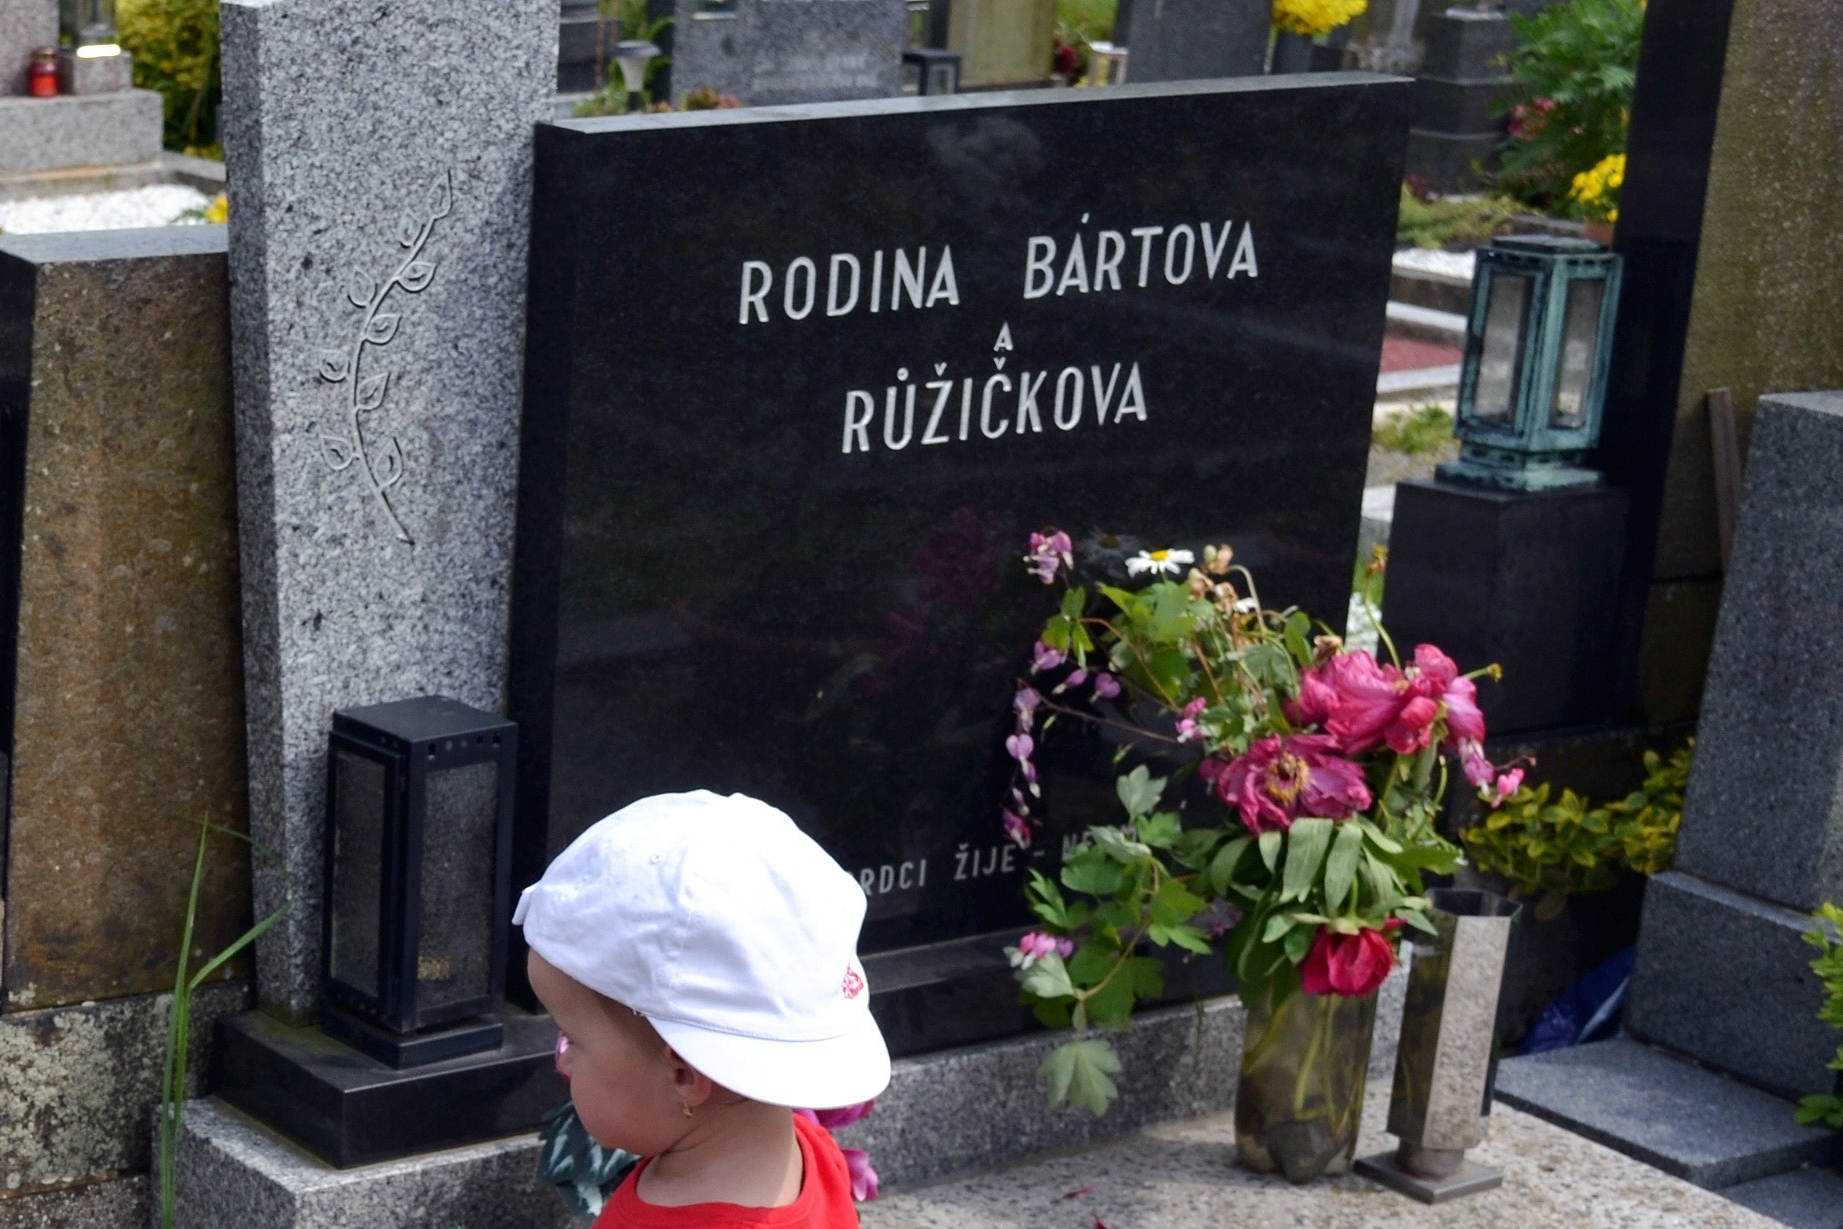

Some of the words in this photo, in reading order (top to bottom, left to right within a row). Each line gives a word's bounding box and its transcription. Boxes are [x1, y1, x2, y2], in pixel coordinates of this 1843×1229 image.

[738, 245, 960, 325] RODINA
[1023, 212, 1259, 300] BÁRTOVA
[993, 322, 1014, 352] A
[841, 357, 1148, 454] RŮŽIČKOVA
[955, 842, 1017, 881] ŽIJE
